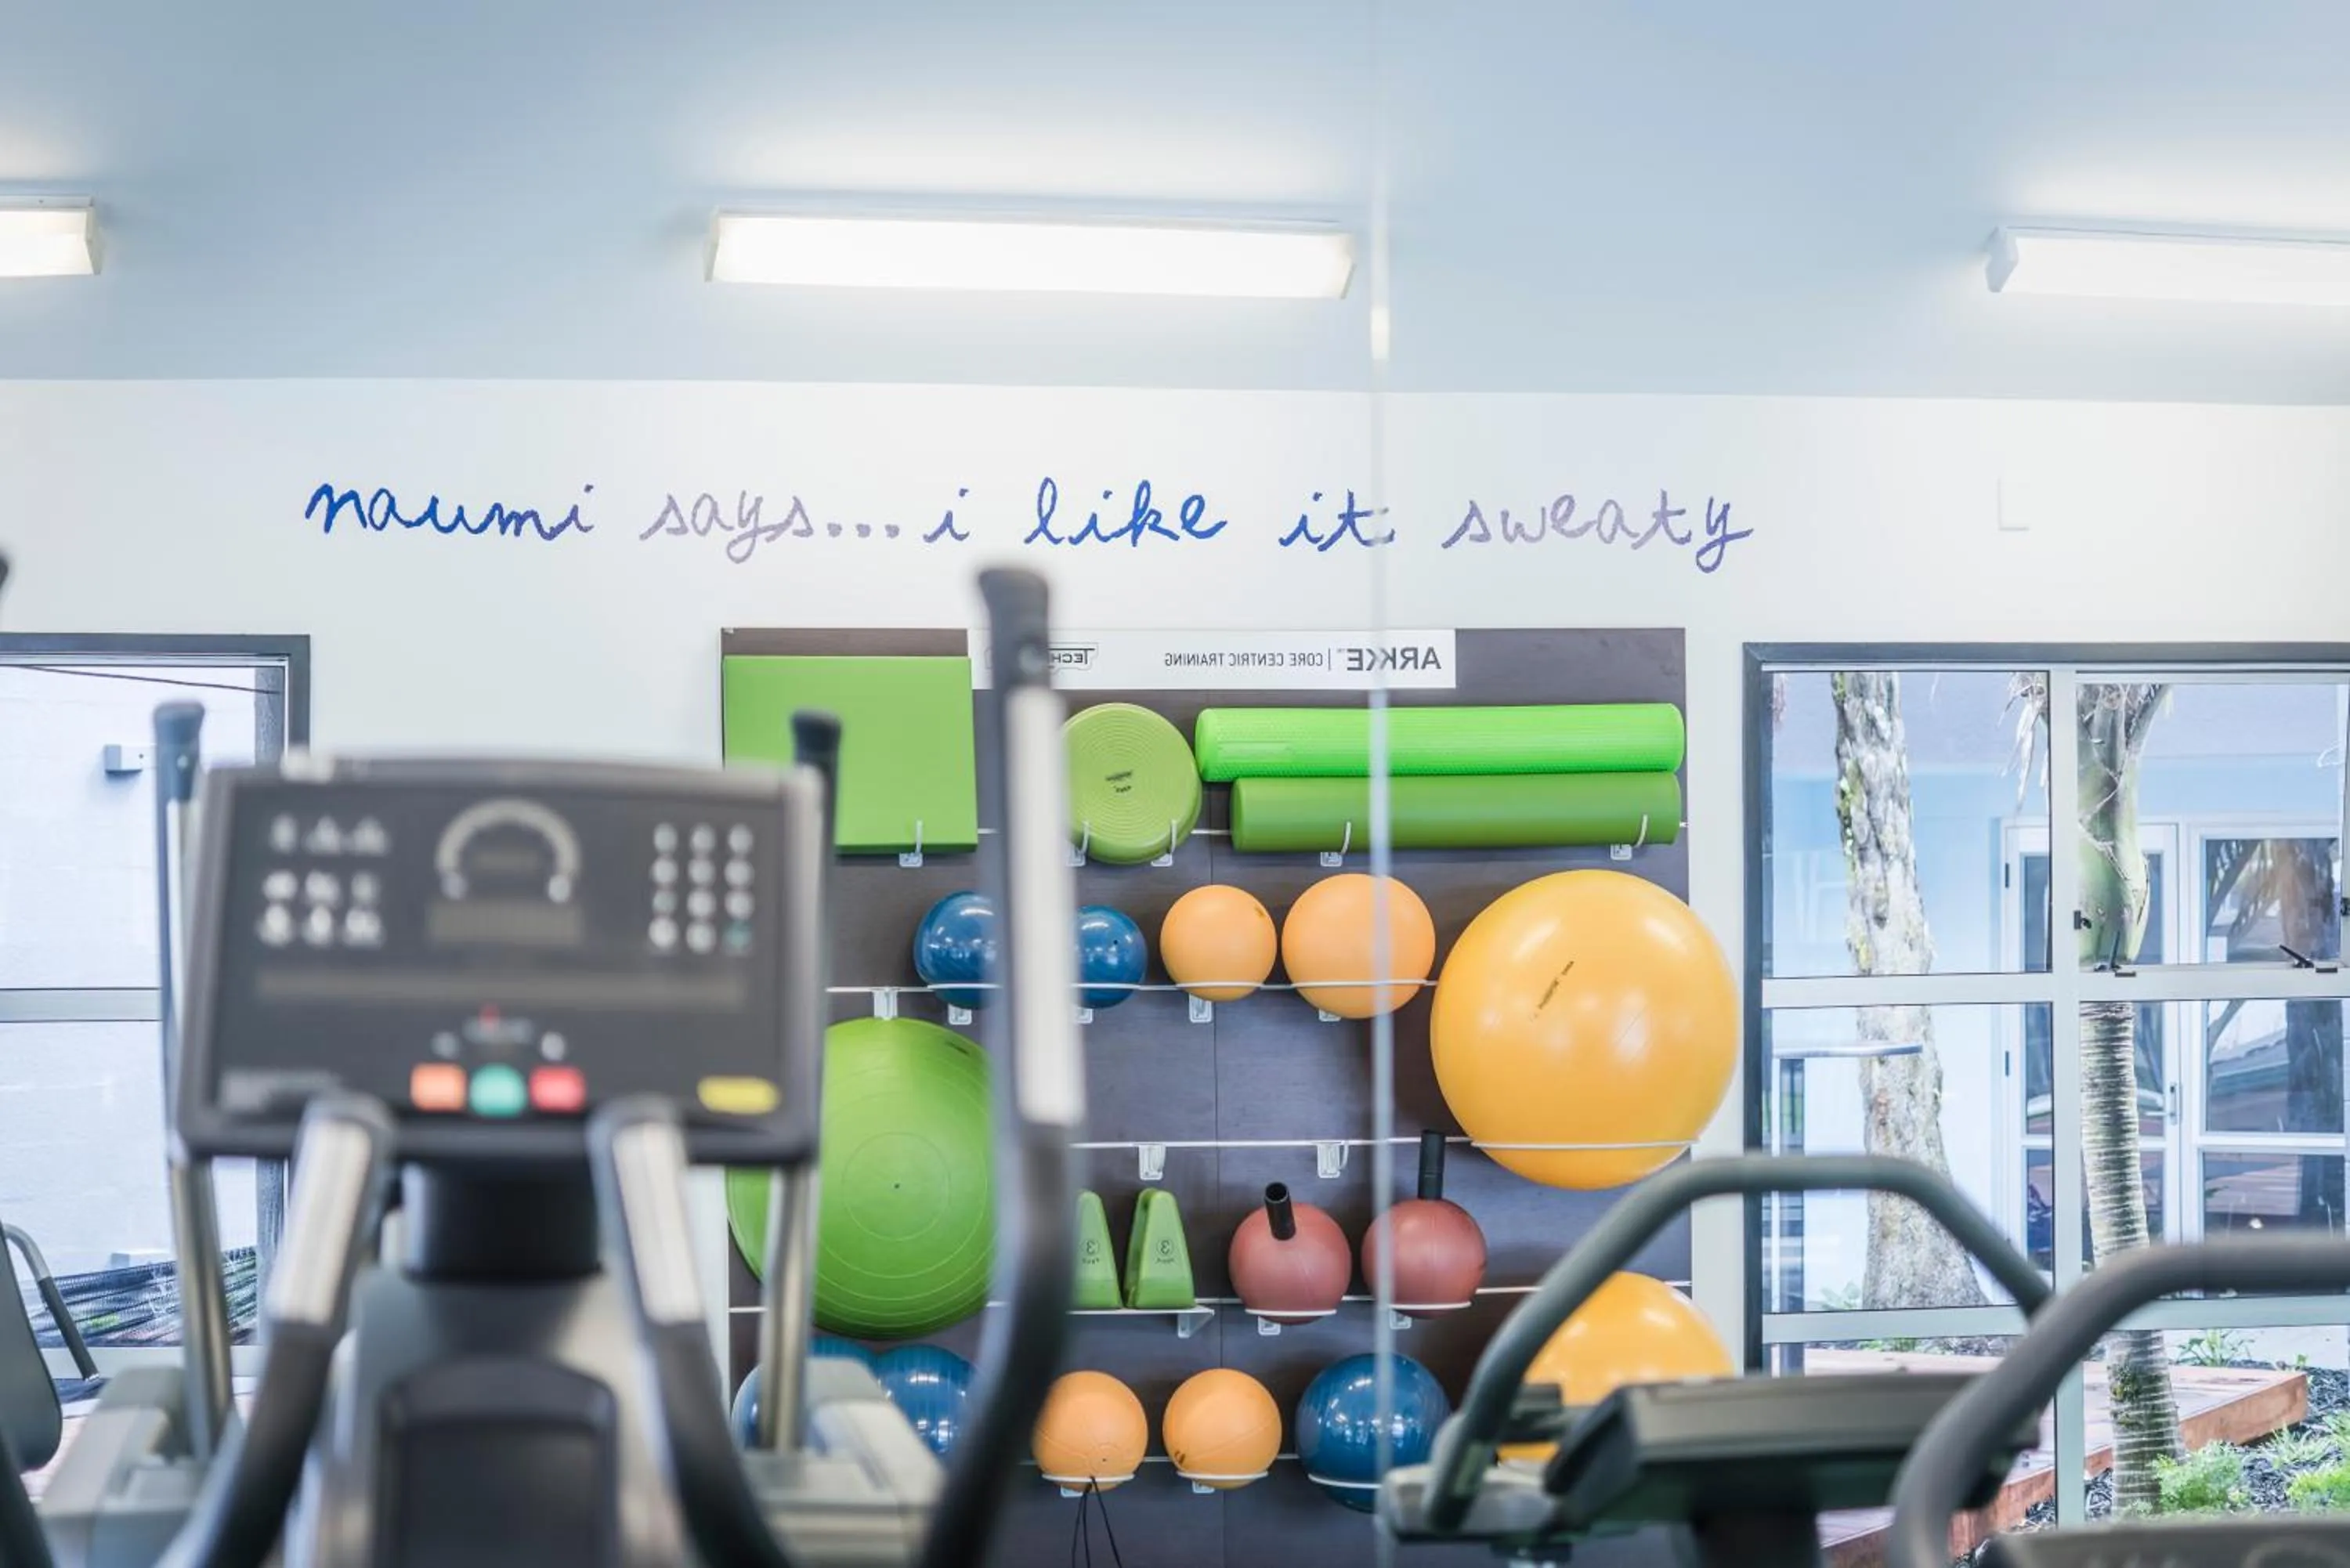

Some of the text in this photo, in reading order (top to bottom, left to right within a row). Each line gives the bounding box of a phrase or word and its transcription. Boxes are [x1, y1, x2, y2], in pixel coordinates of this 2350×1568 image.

[304, 482, 594, 541] naumi
[923, 488, 970, 543] i
[1024, 477, 1227, 547] like
[1278, 488, 1396, 552] it
[1441, 490, 1754, 573] sweaty
